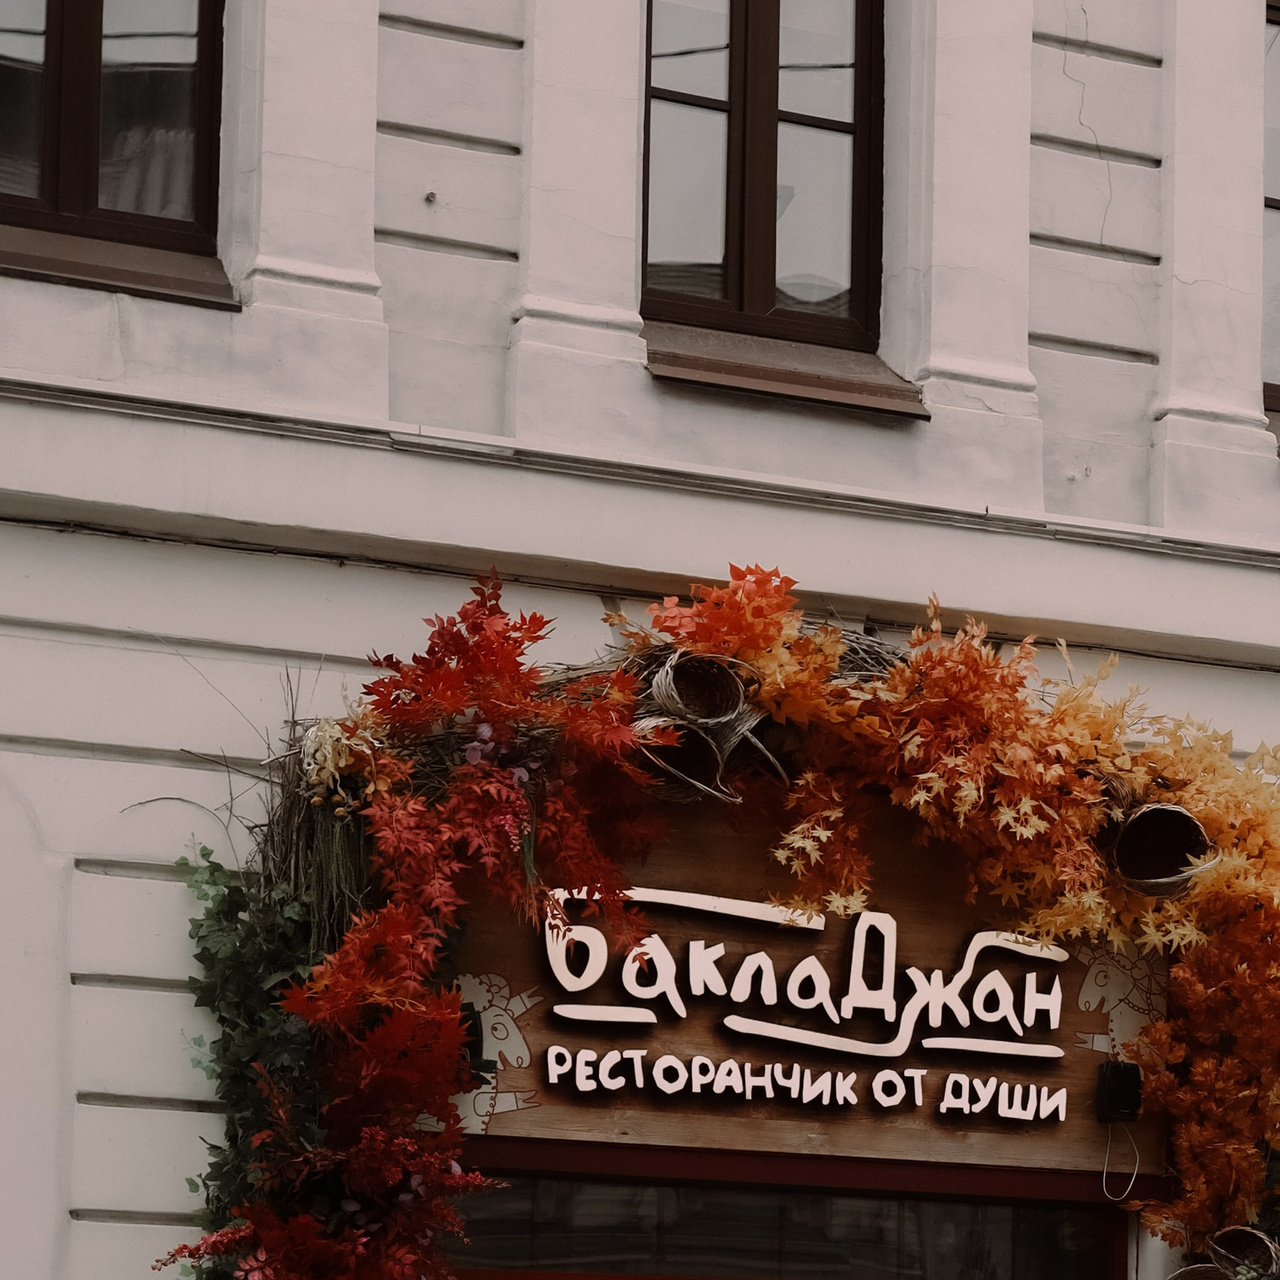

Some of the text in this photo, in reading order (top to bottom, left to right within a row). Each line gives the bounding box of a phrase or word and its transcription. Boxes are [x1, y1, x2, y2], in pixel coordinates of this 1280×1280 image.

[546, 1044, 1068, 1122] РЕСТОРАНЧИК ОТ ДУШИ
